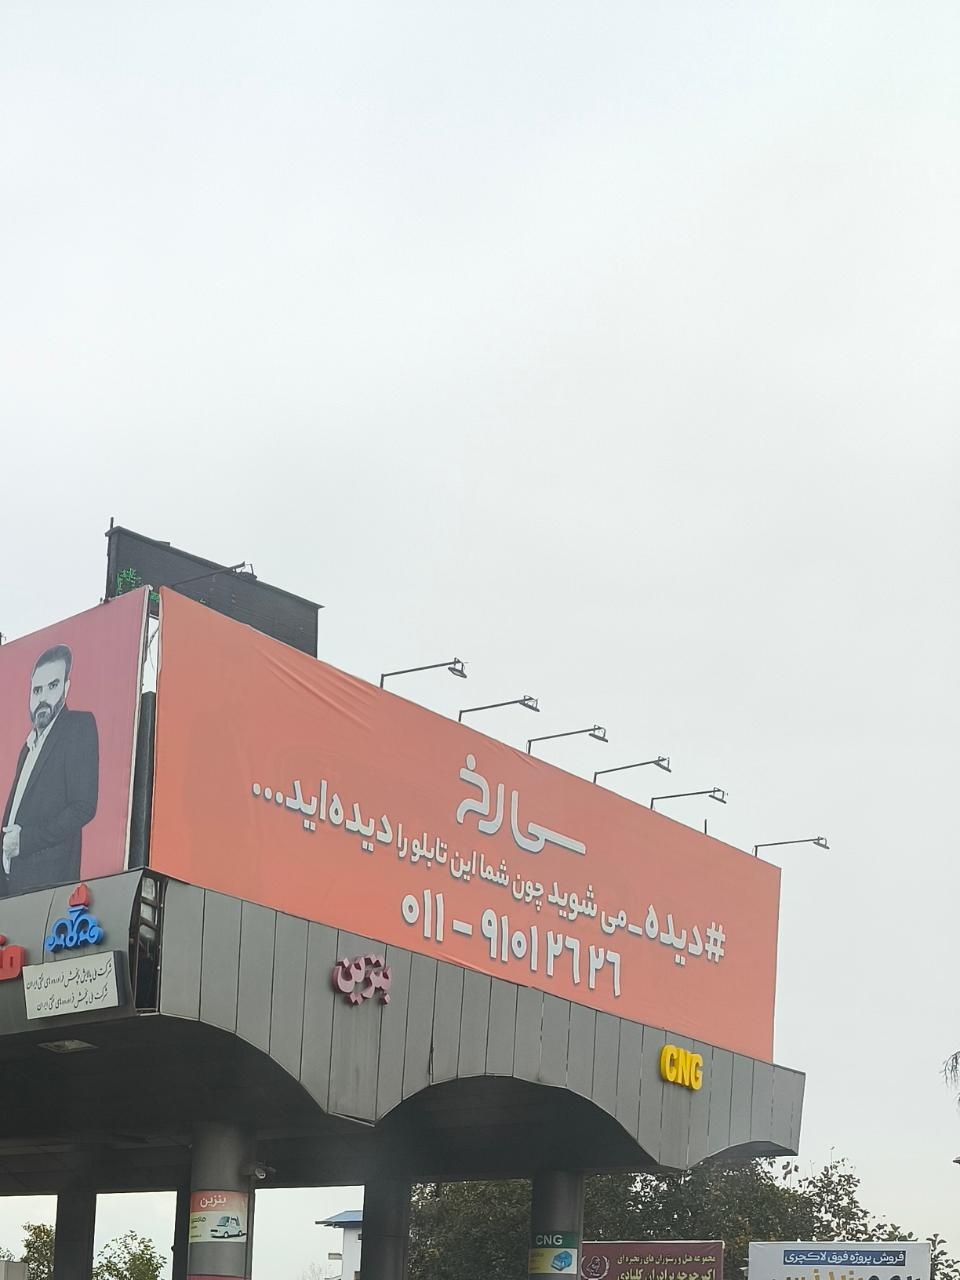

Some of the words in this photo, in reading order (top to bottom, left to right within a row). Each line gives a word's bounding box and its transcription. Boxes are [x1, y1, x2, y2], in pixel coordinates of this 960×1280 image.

[397, 823, 408, 859] را
[410, 832, 448, 867] تابلو
[450, 851, 477, 881] این
[479, 853, 510, 886] شما
[512, 873, 545, 911] چون
[548, 882, 599, 921] شوید
[660, 1043, 703, 1090] CNG
[200, 1194, 227, 1208] بنزین
[536, 1234, 563, 1245] CNG
[784, 1251, 827, 1264] لاکچری
[827, 1251, 848, 1264] فوق
[850, 1252, 872, 1264] پروژه
[873, 1253, 905, 1264] فروش
